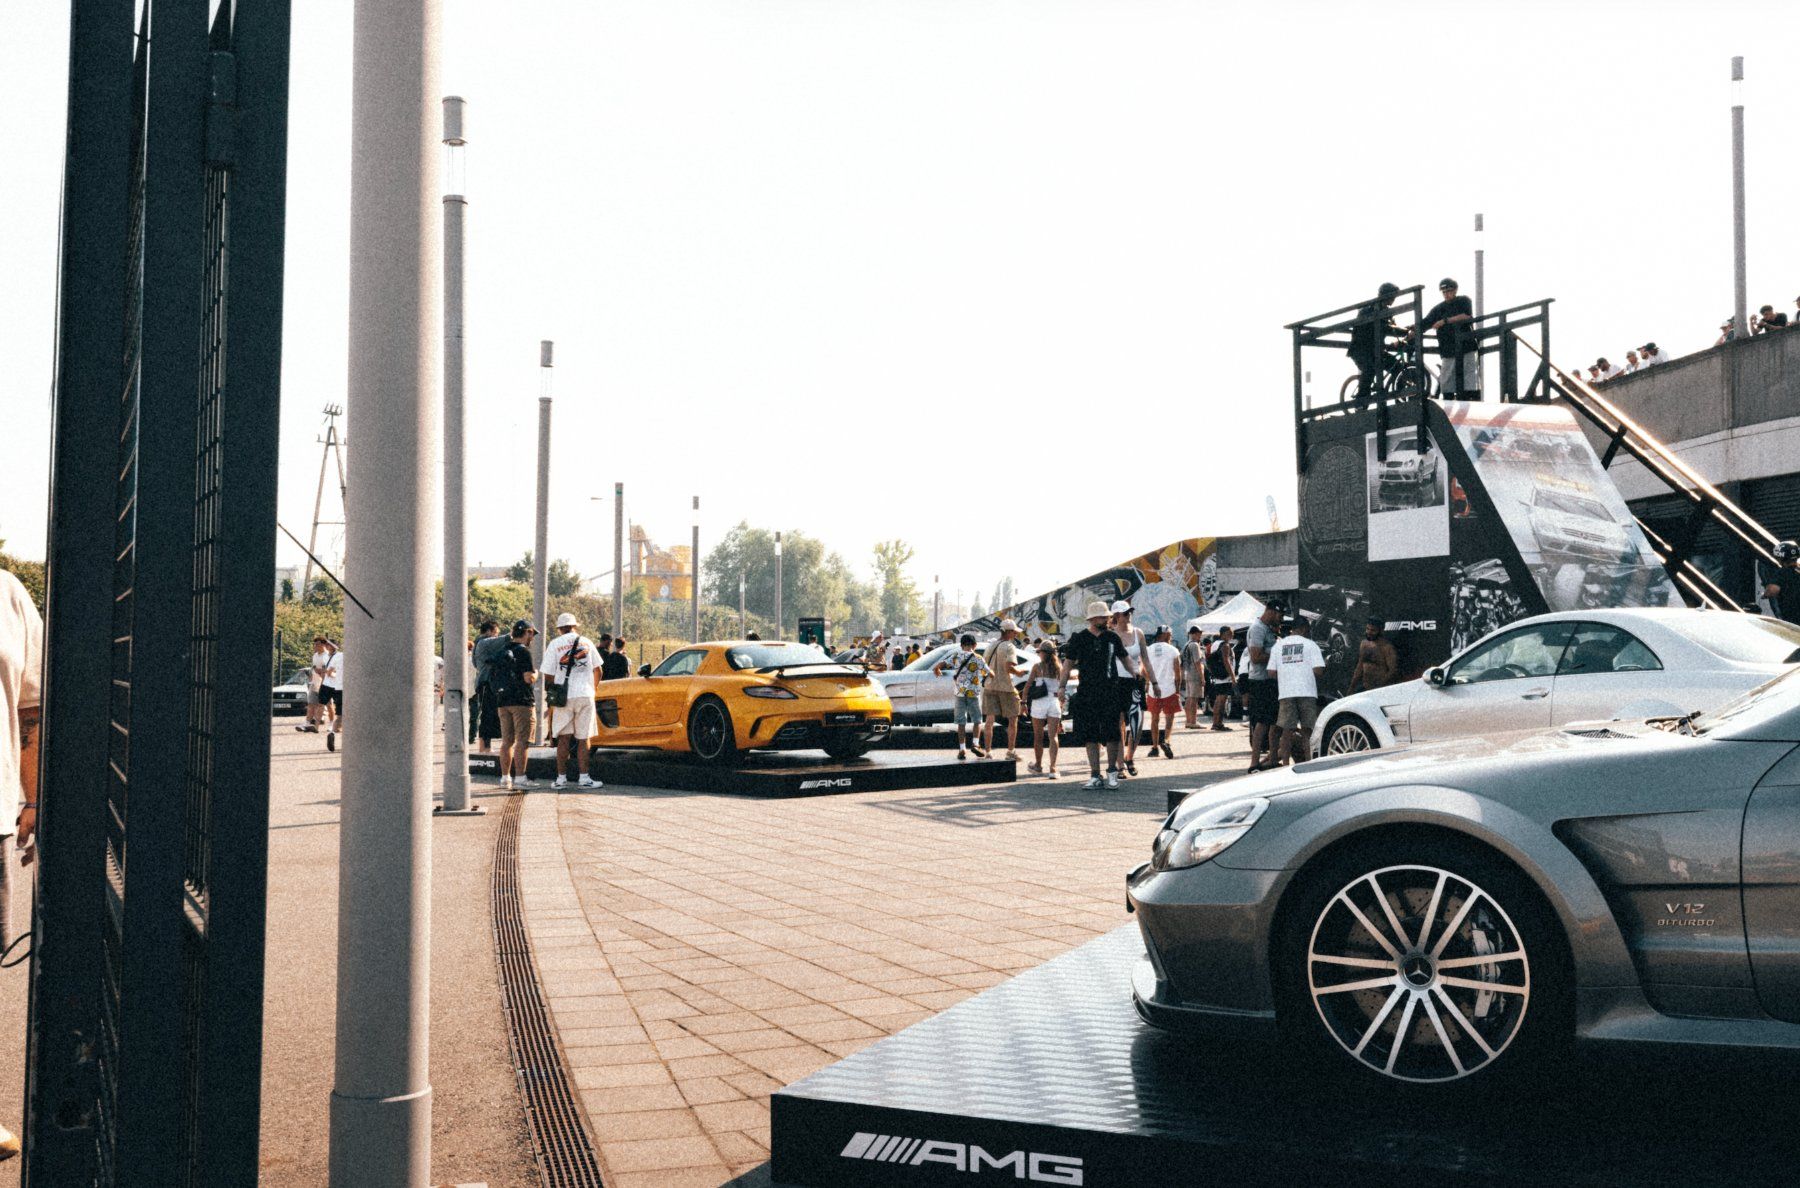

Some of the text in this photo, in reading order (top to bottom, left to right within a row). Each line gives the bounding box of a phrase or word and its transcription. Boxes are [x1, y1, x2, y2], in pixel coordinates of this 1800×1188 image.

[1398, 620, 1437, 631] AMG
[815, 778, 852, 788] AMG
[909, 1140, 1083, 1186] AMG
